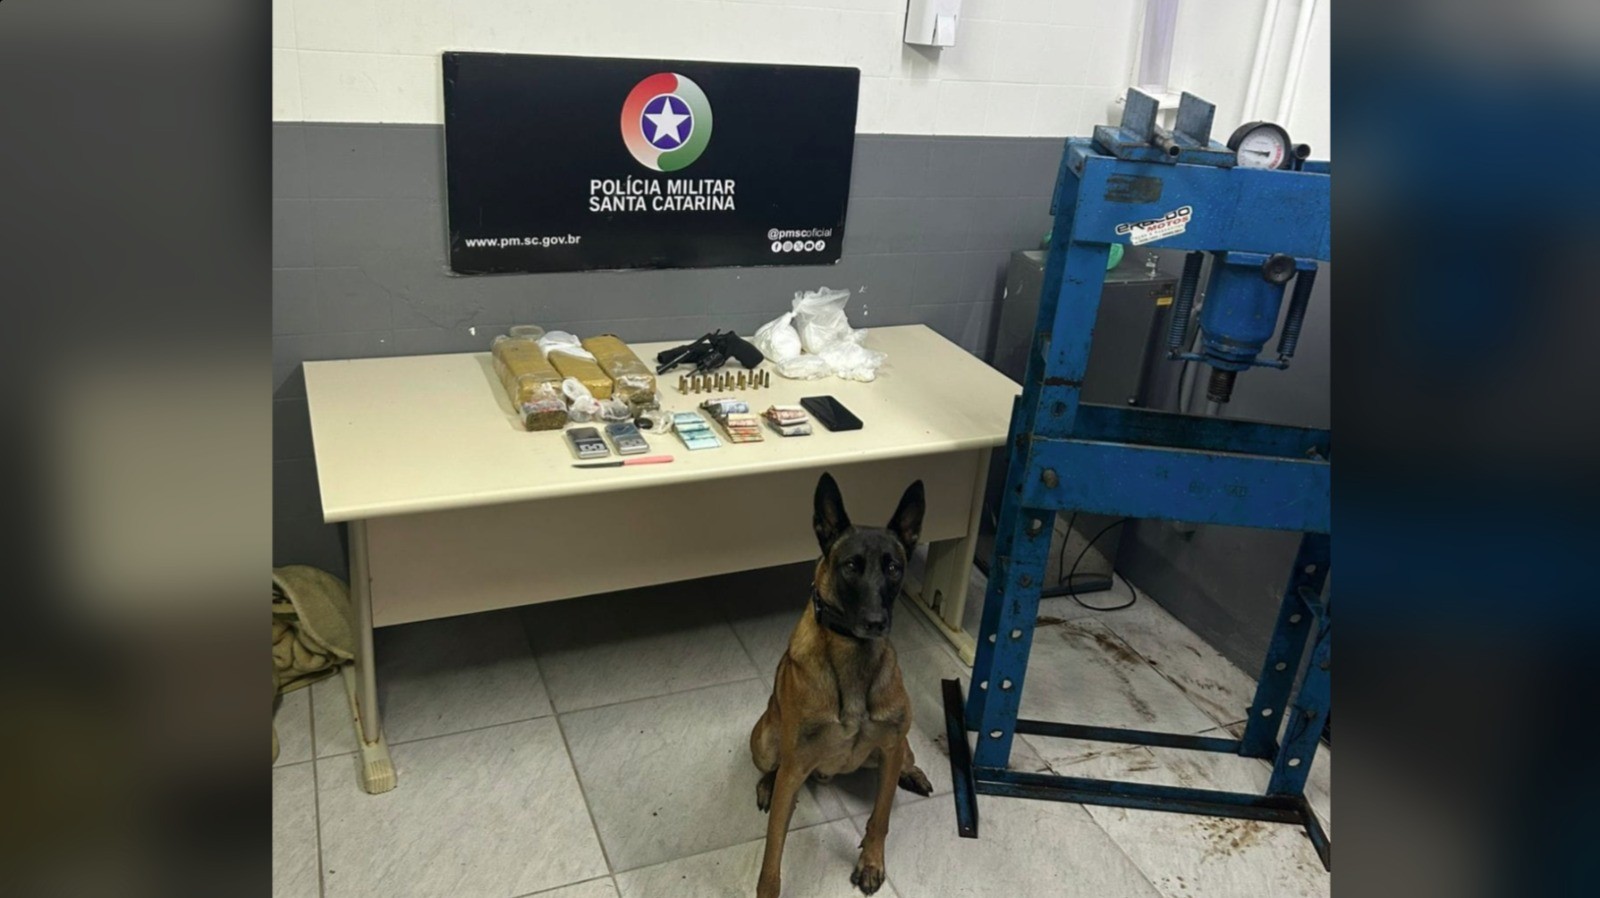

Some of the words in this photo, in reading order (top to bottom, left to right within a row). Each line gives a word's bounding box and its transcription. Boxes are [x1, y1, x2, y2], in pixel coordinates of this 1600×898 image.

[590, 175, 661, 195] POLÍCIA
[667, 179, 735, 195] MILITAR
[589, 196, 647, 212] SANTA
[652, 196, 735, 211] CATARINA
[1146, 216, 1188, 232] MOTOS
[465, 234, 581, 248] www.pm.sc.gov.br
[768, 228, 832, 240] @pmscoficial
